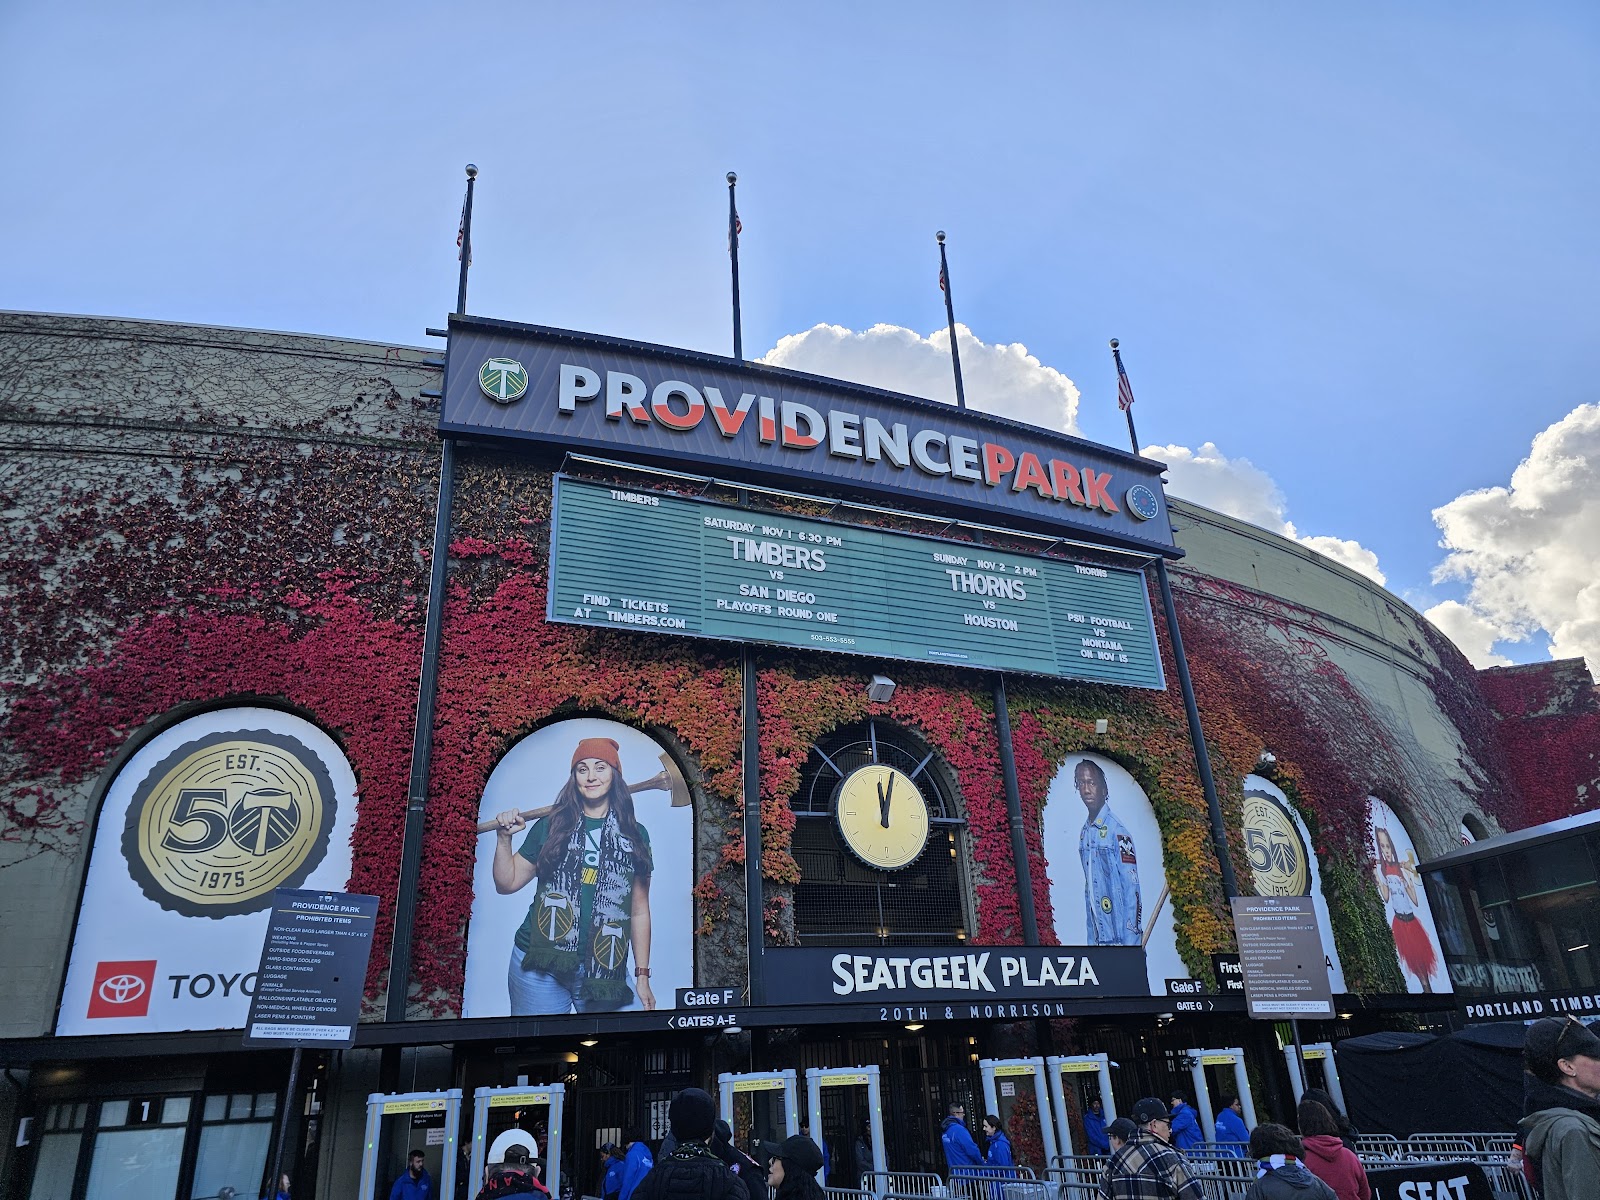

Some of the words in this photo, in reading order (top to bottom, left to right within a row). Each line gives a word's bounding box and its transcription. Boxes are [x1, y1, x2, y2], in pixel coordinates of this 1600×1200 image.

[611, 490, 659, 506] TIMBERS
[704, 517, 755, 533] SATURDAY
[762, 526, 783, 537] NOV
[826, 536, 842, 546] PM
[727, 536, 826, 572] TIMBERS
[933, 553, 968, 566] SUNDAY
[977, 560, 996, 571] NOV
[1000, 563, 1005, 571] 2
[1015, 566, 1021, 574] 2
[1022, 567, 1037, 576] PM
[1074, 565, 1107, 577] THORNS
[769, 570, 784, 580] VS
[945, 569, 1027, 601] THORNS
[739, 584, 769, 599] SAN
[776, 588, 816, 604] DIEGO
[583, 594, 610, 606] FIND
[621, 598, 669, 613] TICKETS
[717, 599, 771, 614] PLAYOFFS
[778, 606, 813, 619] ROUND
[817, 613, 838, 622] ONE
[982, 600, 996, 610] VS
[574, 608, 591, 618] AT
[607, 611, 685, 628] TIMBERS.COM
[964, 614, 1018, 631] HOUSTON
[1067, 613, 1085, 623] PSU
[1090, 616, 1133, 630] FOOTBALL
[1093, 628, 1106, 637] VS
[1082, 638, 1123, 651] MONTANA
[1081, 649, 1093, 658] ON
[1097, 651, 1114, 661] NOV
[225, 754, 261, 772] EST.
[200, 870, 245, 889] 1975
[1272, 885, 1289, 896] 1975
[292, 902, 339, 912] PROVIDENCE
[296, 914, 332, 922] PROHIBITED
[832, 952, 996, 996] SEATGEEK
[1000, 956, 1099, 987] PLAZA
[1220, 962, 1242, 974] First
[1171, 981, 1194, 993] Gate
[1195, 981, 1202, 992] F
[1226, 980, 1243, 989] First
[684, 991, 720, 1006] Gate
[724, 990, 734, 1004] F
[880, 1007, 928, 1021] 20TH
[945, 1006, 954, 1019] &
[970, 1004, 1065, 1018] MORRISON
[1177, 1002, 1196, 1011] GATE
[1196, 1002, 1202, 1011] G
[1466, 1000, 1543, 1018] PORTLAND
[678, 1016, 714, 1027] GATES
[716, 1014, 736, 1026] A-E
[141, 1101, 150, 1122] 1
